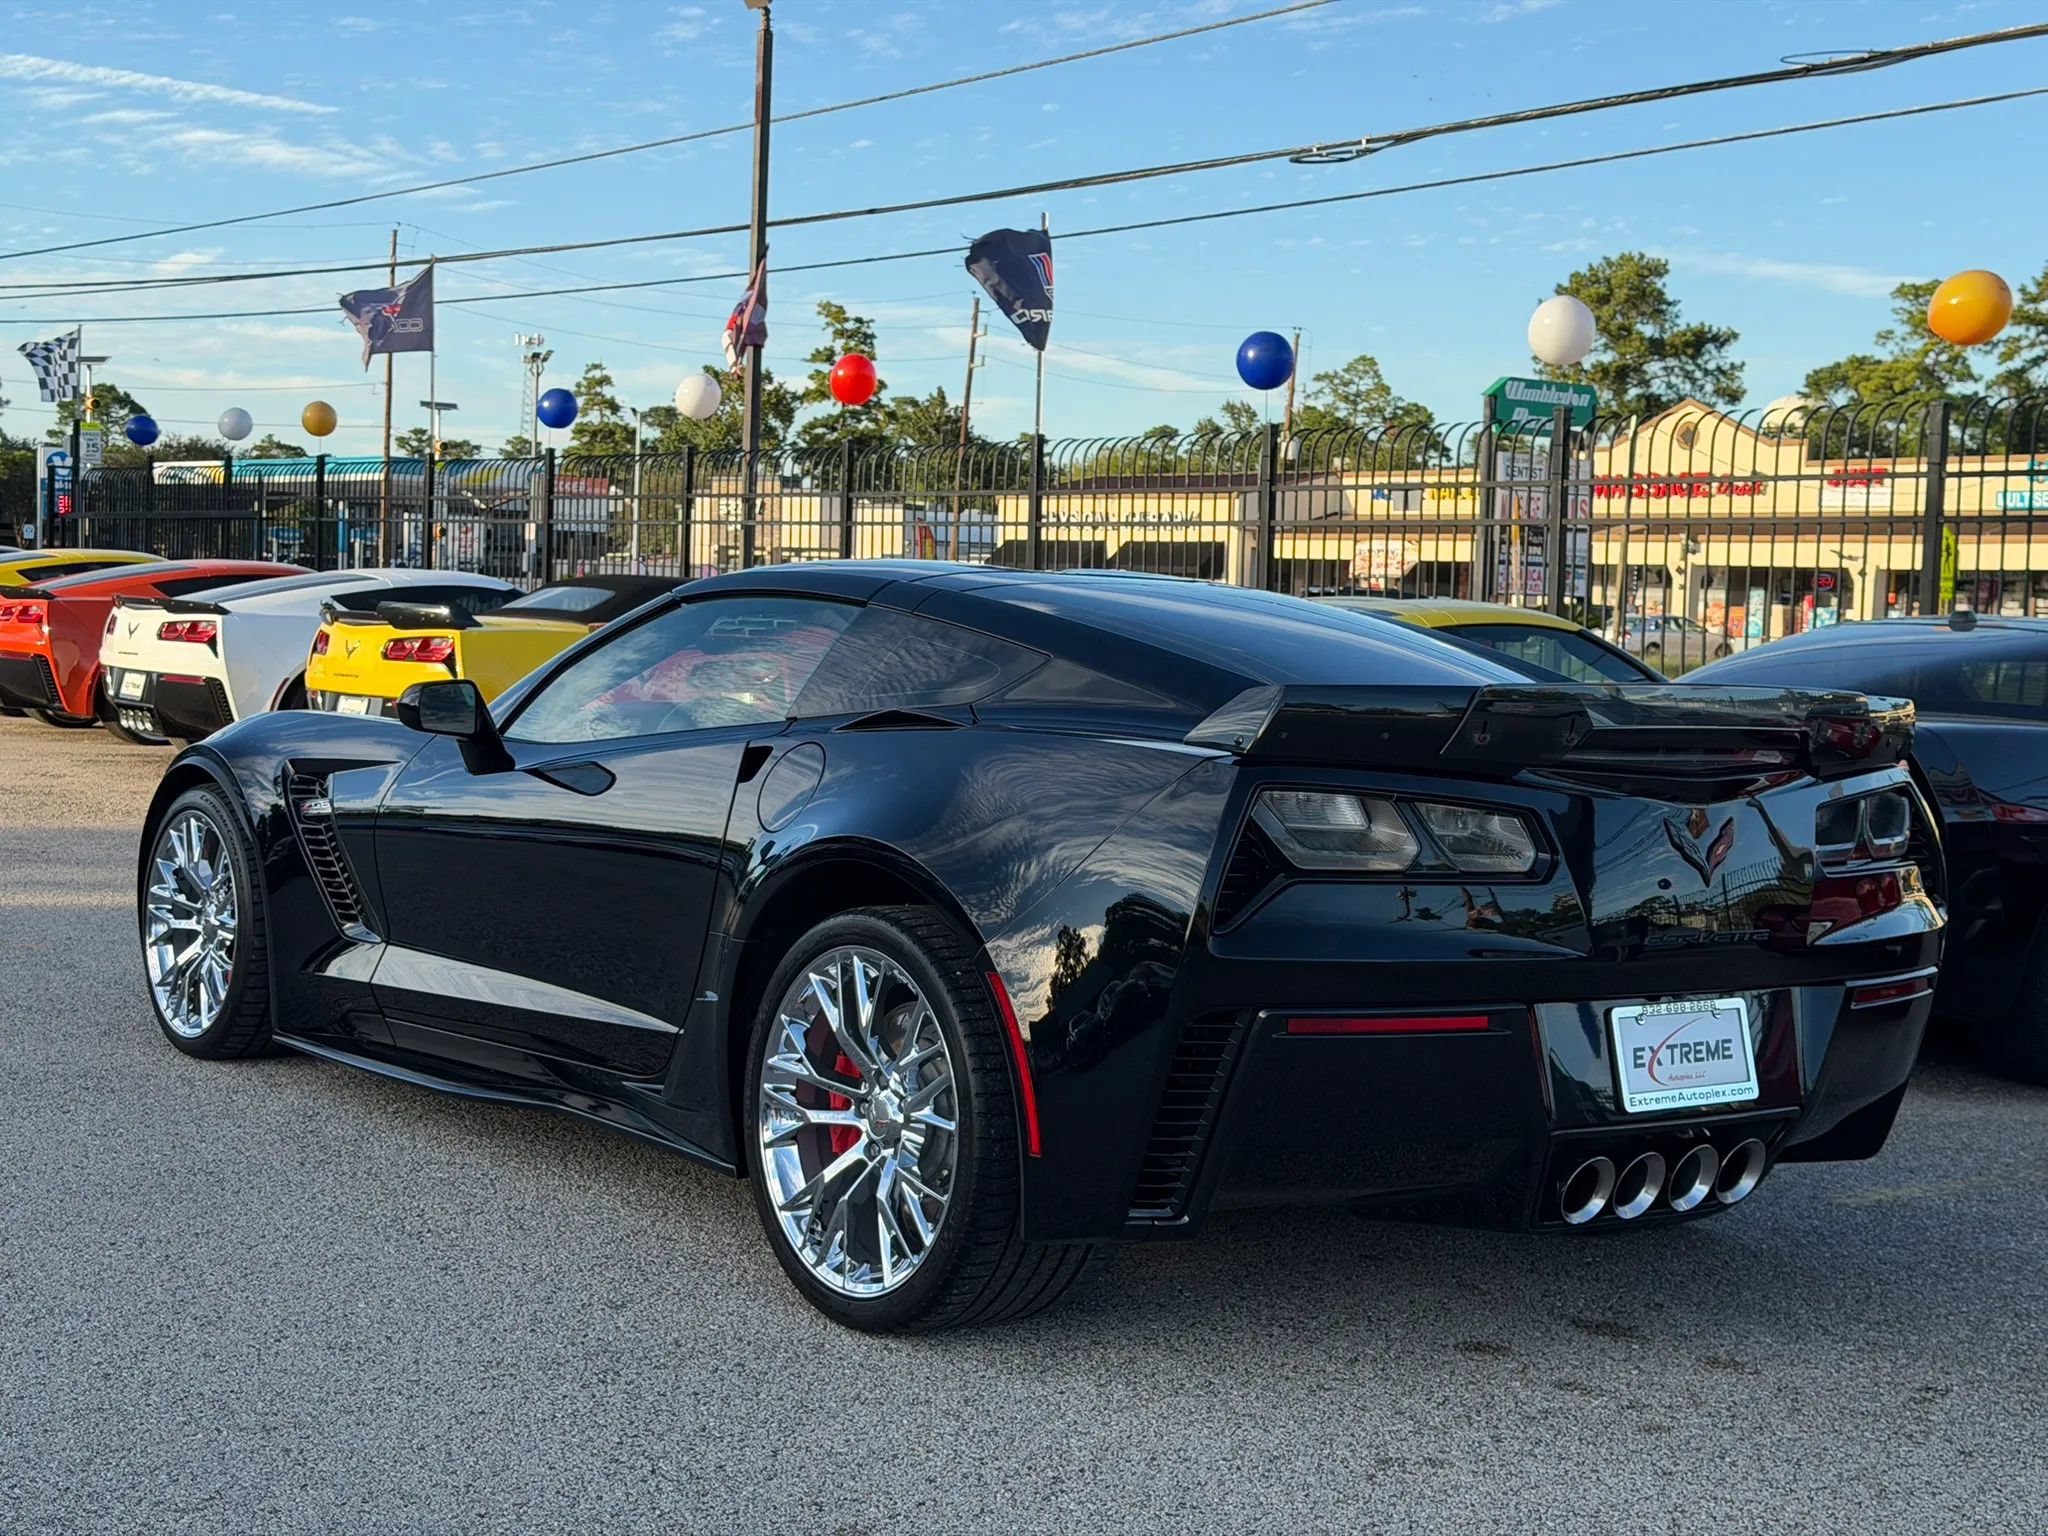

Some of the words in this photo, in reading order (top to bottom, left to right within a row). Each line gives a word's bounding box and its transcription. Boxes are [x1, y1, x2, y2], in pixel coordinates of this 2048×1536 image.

[1505, 381, 1591, 407] Wimbledon
[1506, 465, 1543, 479] DENTIST
[1633, 1038, 1733, 1069] EXTREME
[1630, 1086, 1754, 1108] ExtremeAutoplex.com
